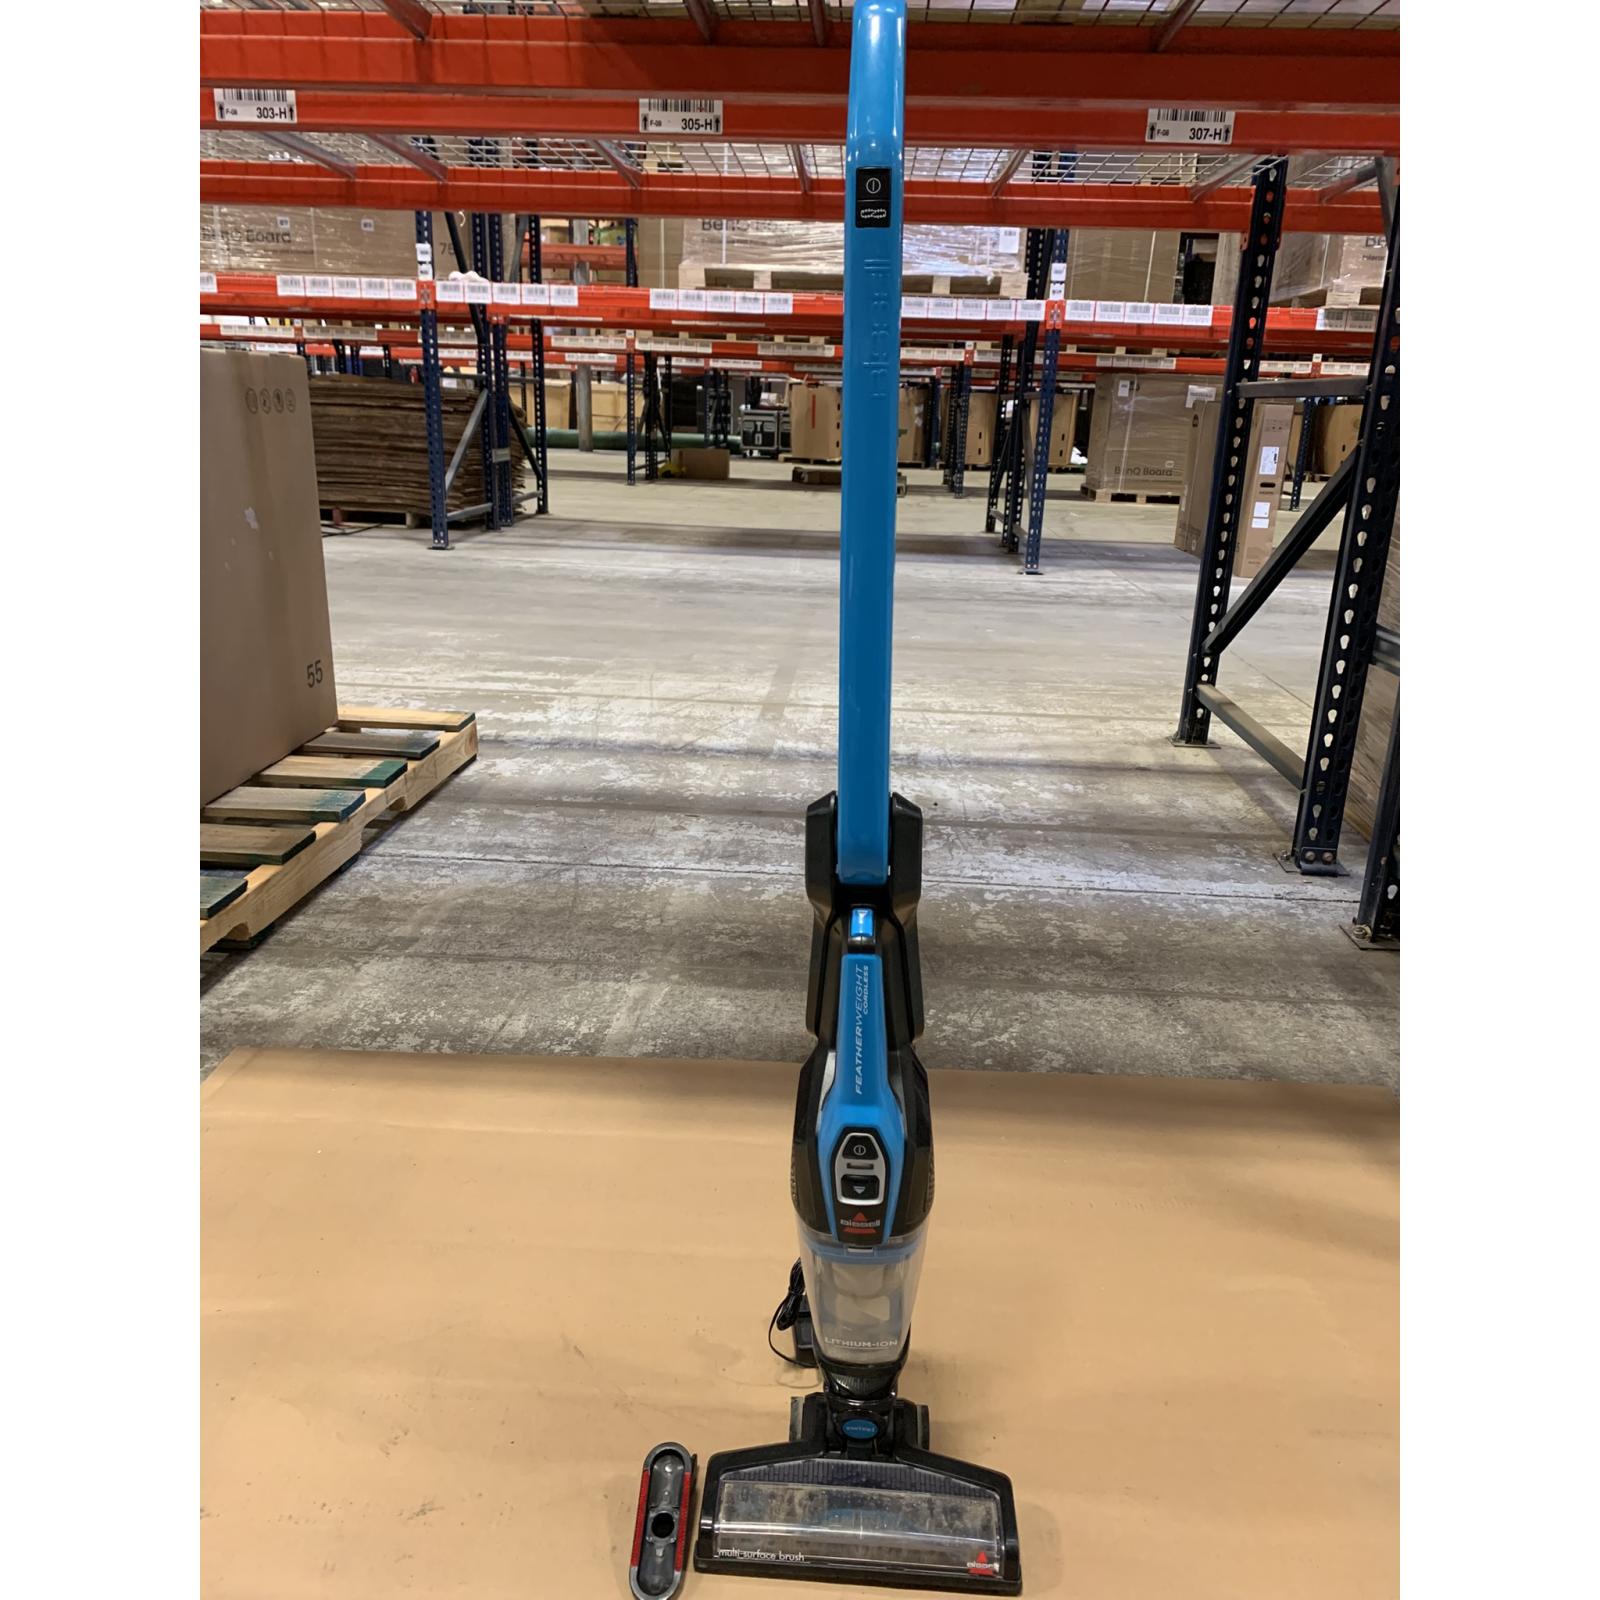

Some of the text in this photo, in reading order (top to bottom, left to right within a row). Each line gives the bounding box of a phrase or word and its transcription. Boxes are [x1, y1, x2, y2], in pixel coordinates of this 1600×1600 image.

[256, 106, 287, 119] 303-H
[681, 118, 713, 131] 305-H
[1188, 127, 1222, 141] 307-H
[306, 659, 323, 688] 55
[855, 963, 864, 1095] FEATHERWEIGHT
[824, 1336, 898, 1347] LITHIUM-ION
[779, 1550, 805, 1561] brush
